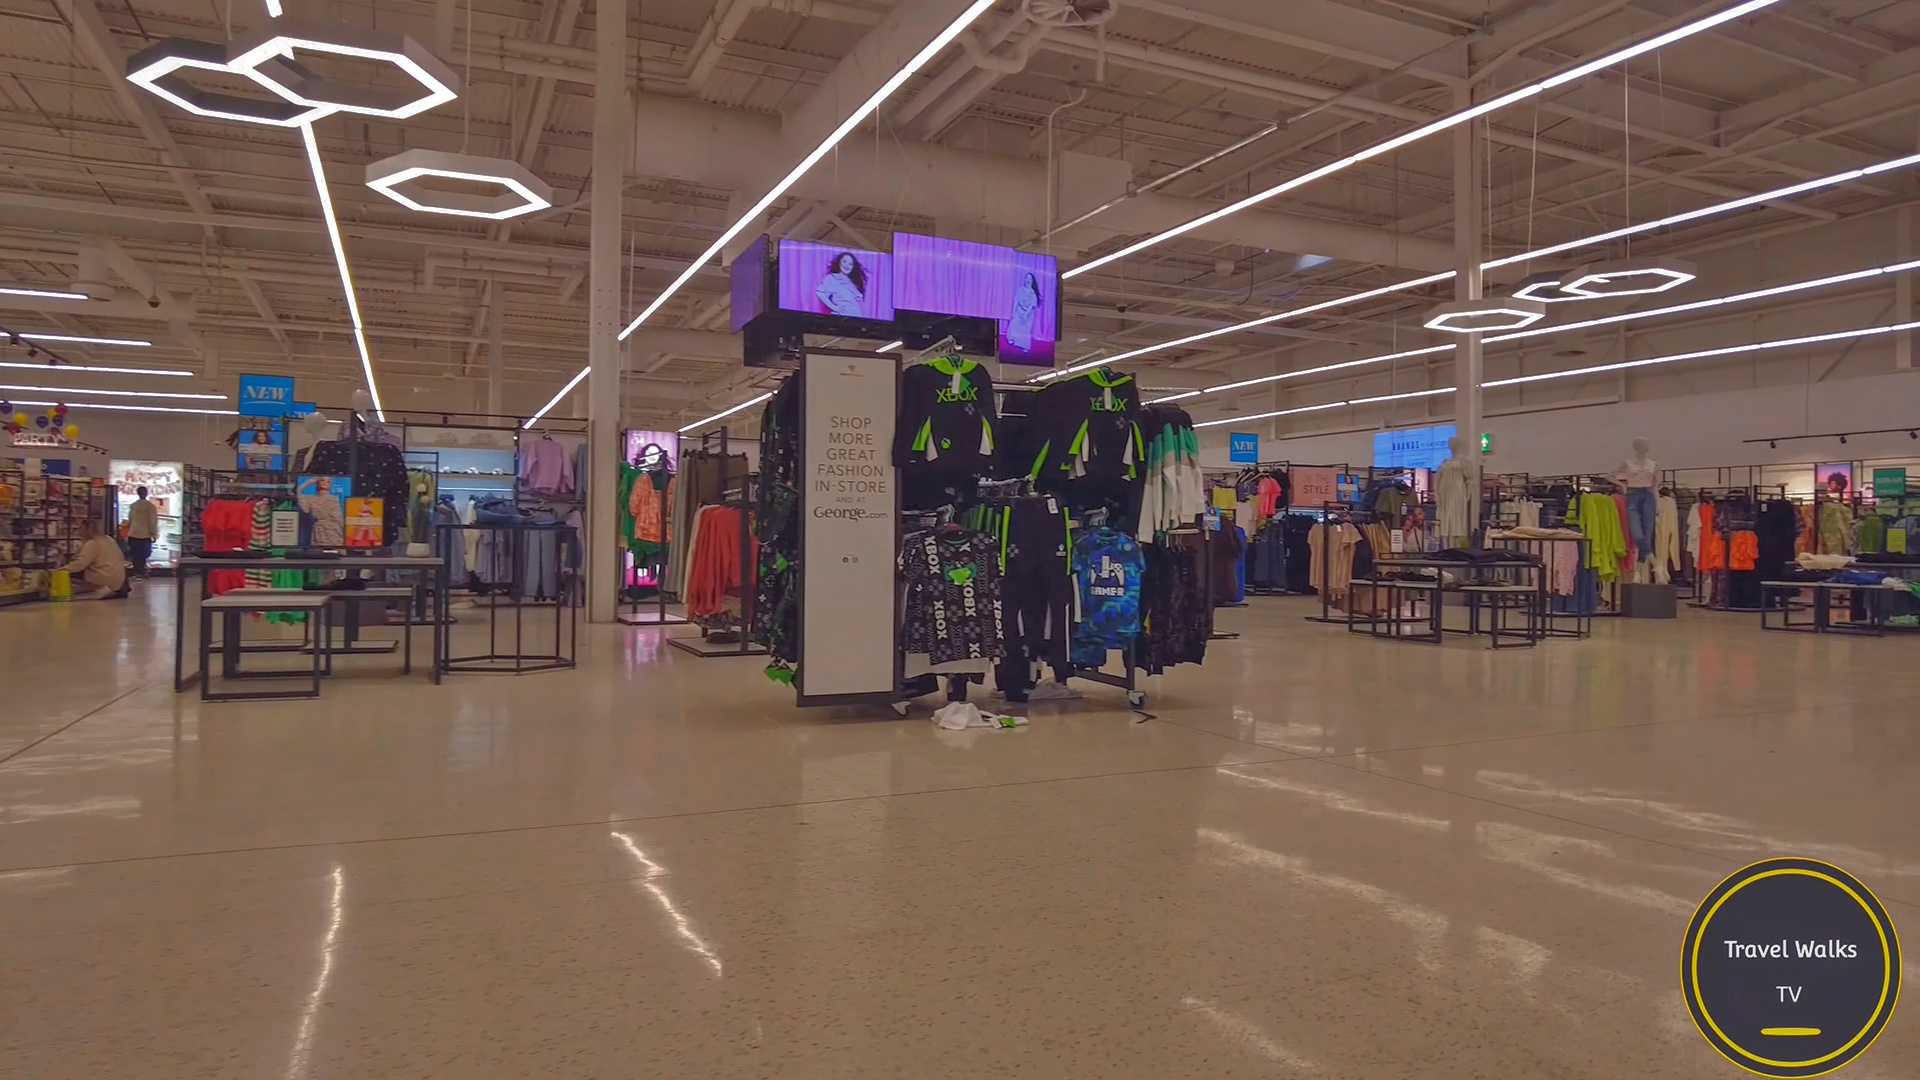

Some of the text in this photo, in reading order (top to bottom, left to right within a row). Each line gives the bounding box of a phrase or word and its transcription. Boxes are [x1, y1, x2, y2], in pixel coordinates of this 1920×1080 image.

[244, 385, 290, 400] NEW
[830, 416, 872, 429] SHOP
[14, 433, 62, 446] PARTY
[829, 432, 873, 445] MORE
[1232, 441, 1256, 451] NEW
[826, 448, 876, 461] GREAT
[818, 463, 884, 477] FASHION
[815, 480, 886, 493] IN-STORE
[1303, 484, 1331, 495] STYLE
[813, 506, 888, 522] George.com
[924, 535, 941, 575] XBOX
[1090, 586, 1124, 597] GAMER
[934, 600, 948, 640] XBOX
[993, 599, 1005, 640] XBOX
